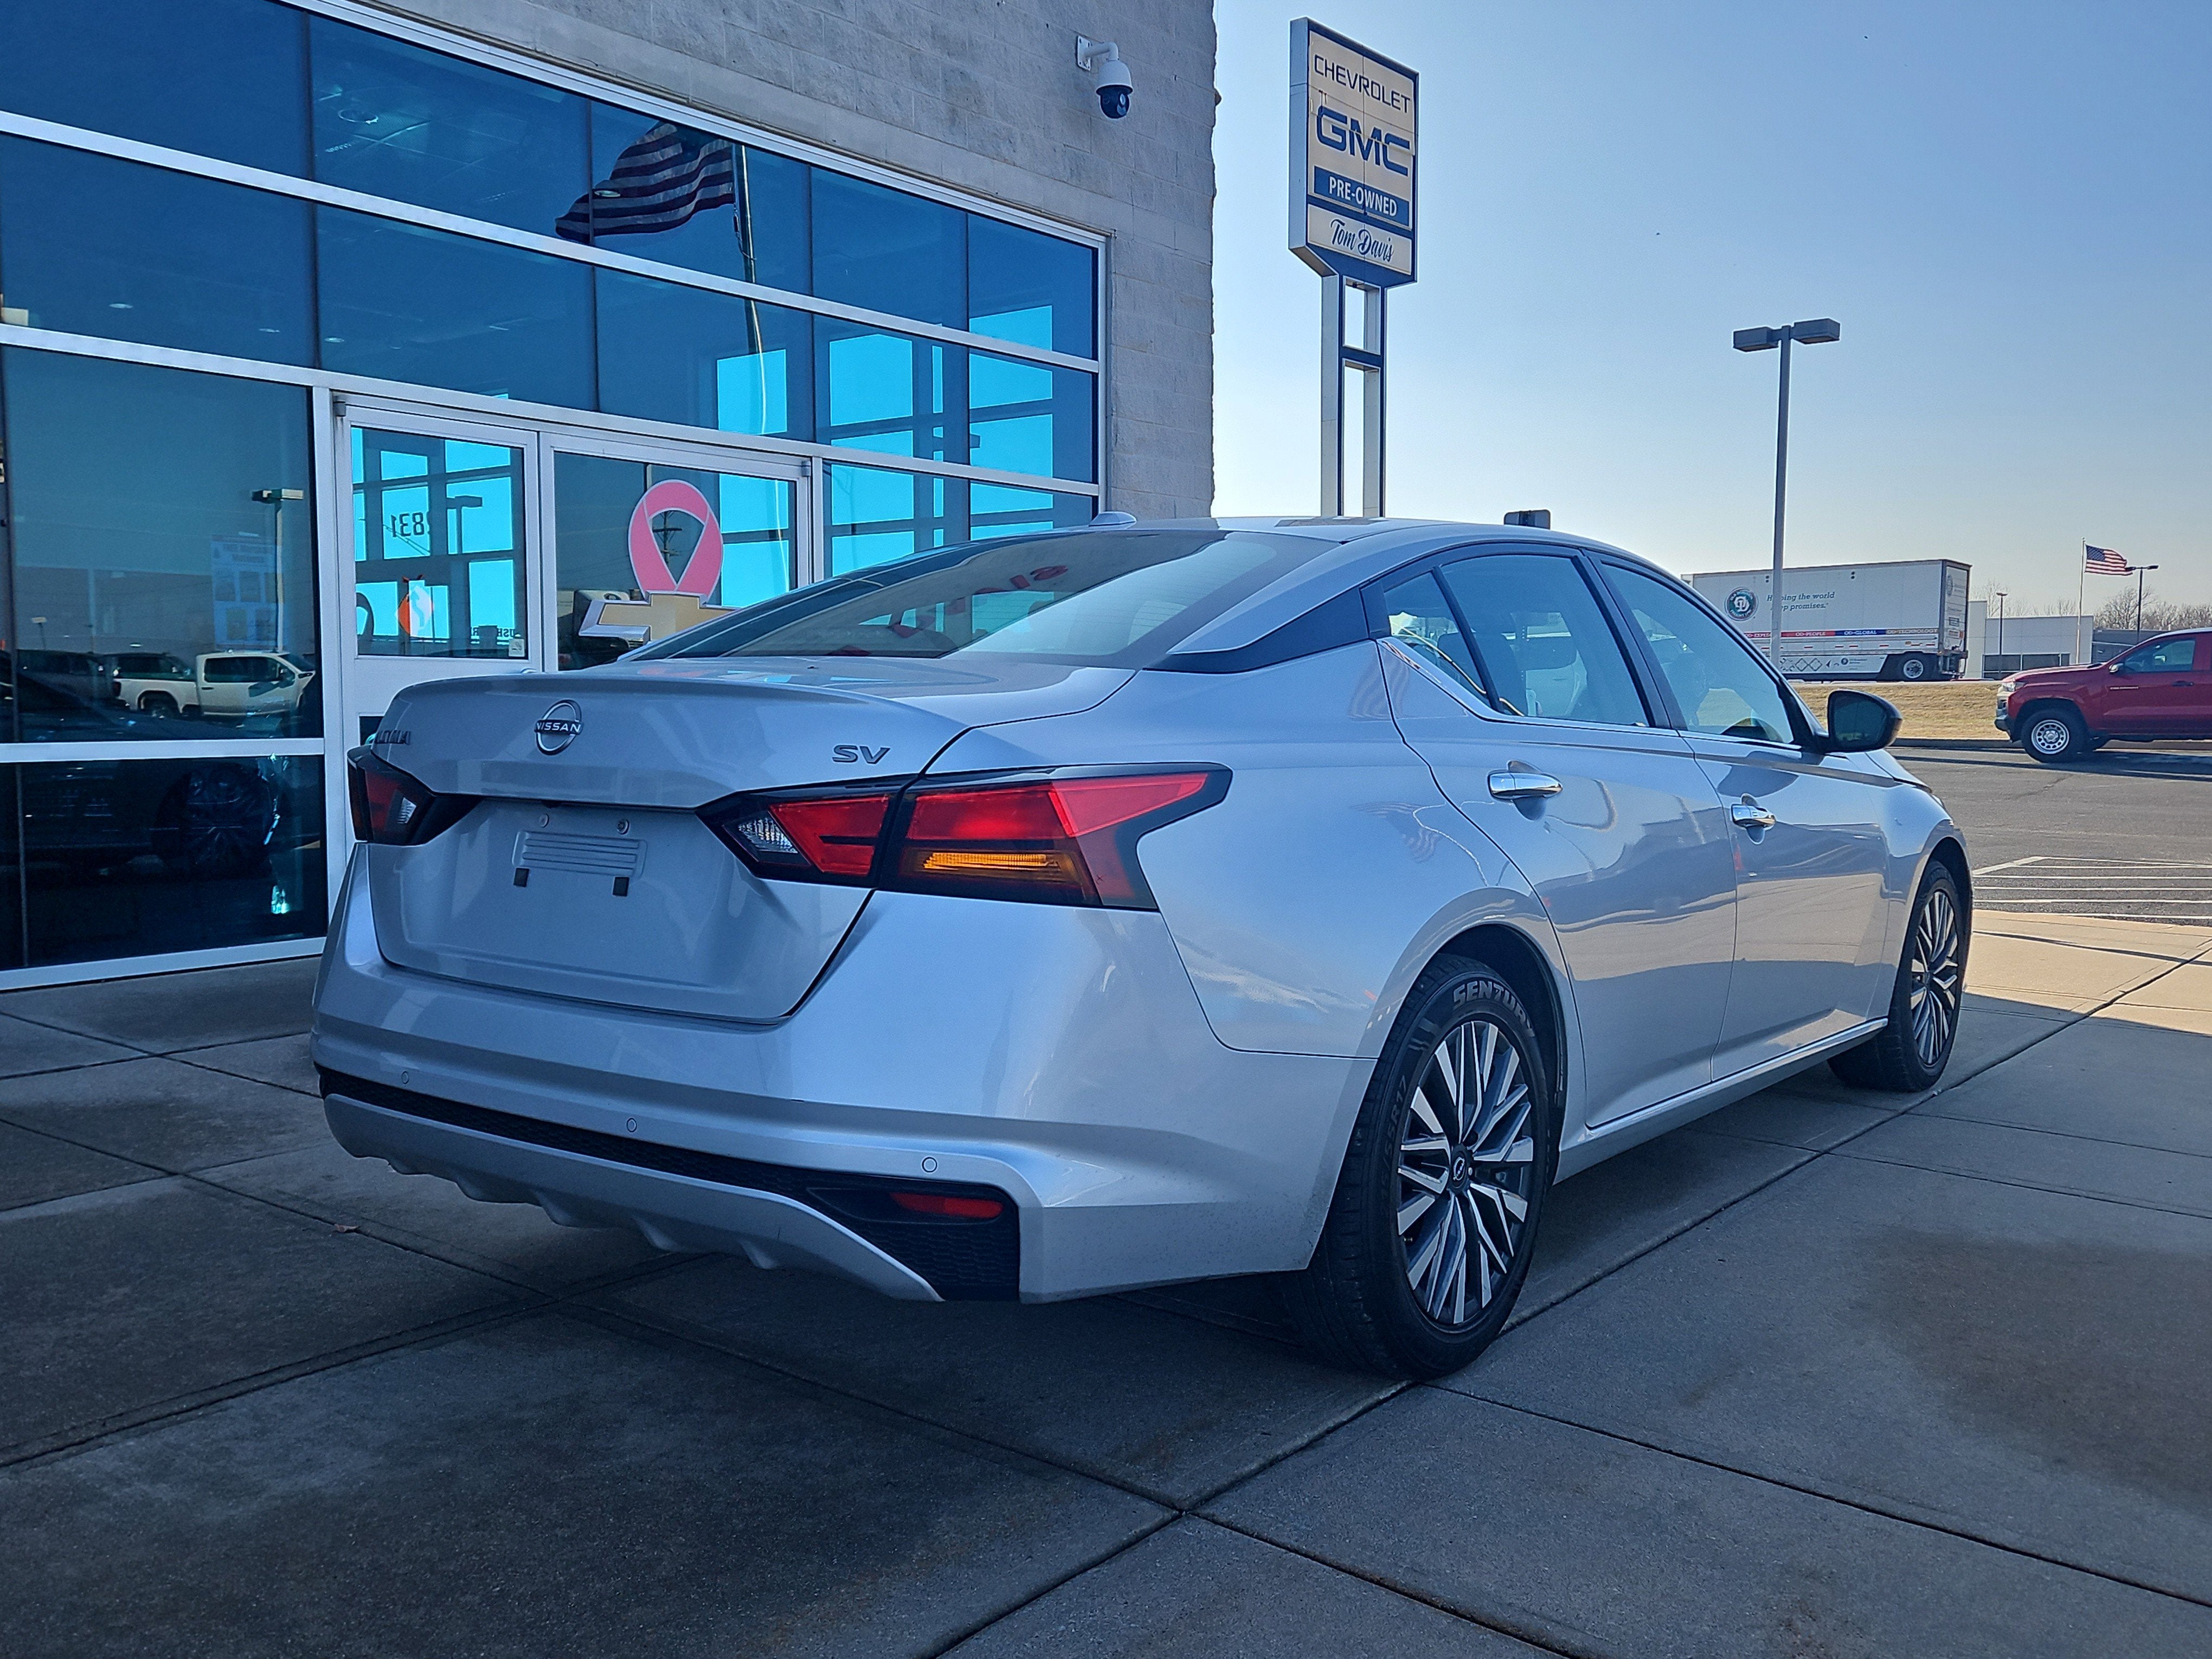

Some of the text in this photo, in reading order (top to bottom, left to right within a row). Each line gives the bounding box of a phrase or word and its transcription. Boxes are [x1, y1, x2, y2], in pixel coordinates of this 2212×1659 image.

[1314, 54, 1411, 113] CHEVROLET
[1316, 106, 1410, 177] GMC
[1329, 176, 1397, 216] PRE-OWNED
[1330, 218, 1394, 262] Tom Davis
[536, 722, 581, 732] NISSAN
[832, 744, 891, 764] SV
